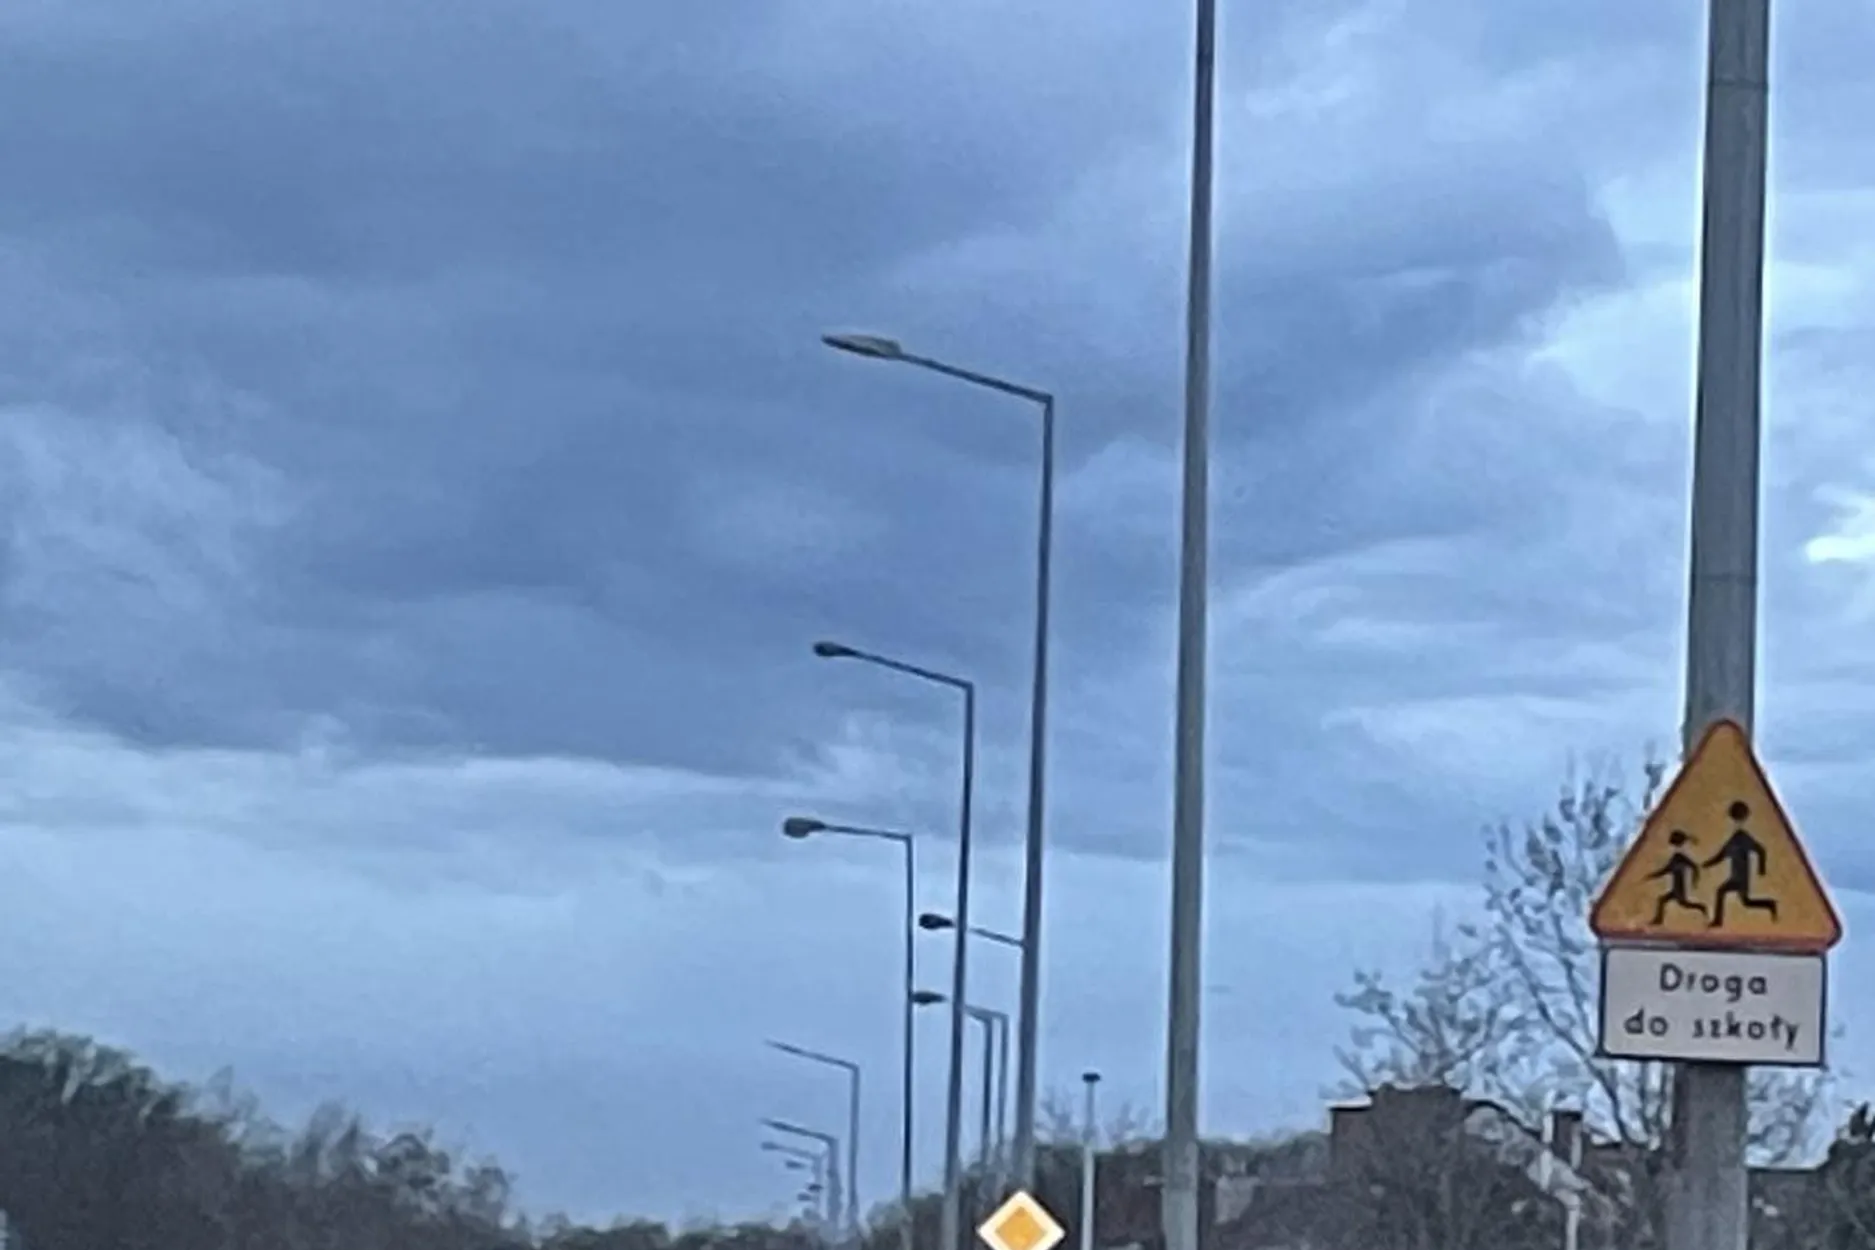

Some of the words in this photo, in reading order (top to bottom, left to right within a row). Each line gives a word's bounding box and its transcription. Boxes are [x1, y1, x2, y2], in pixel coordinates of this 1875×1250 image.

[1660, 963, 1768, 1002] Droga
[1623, 1007, 1669, 1037] do
[1692, 1011, 1799, 1051] szkoły
